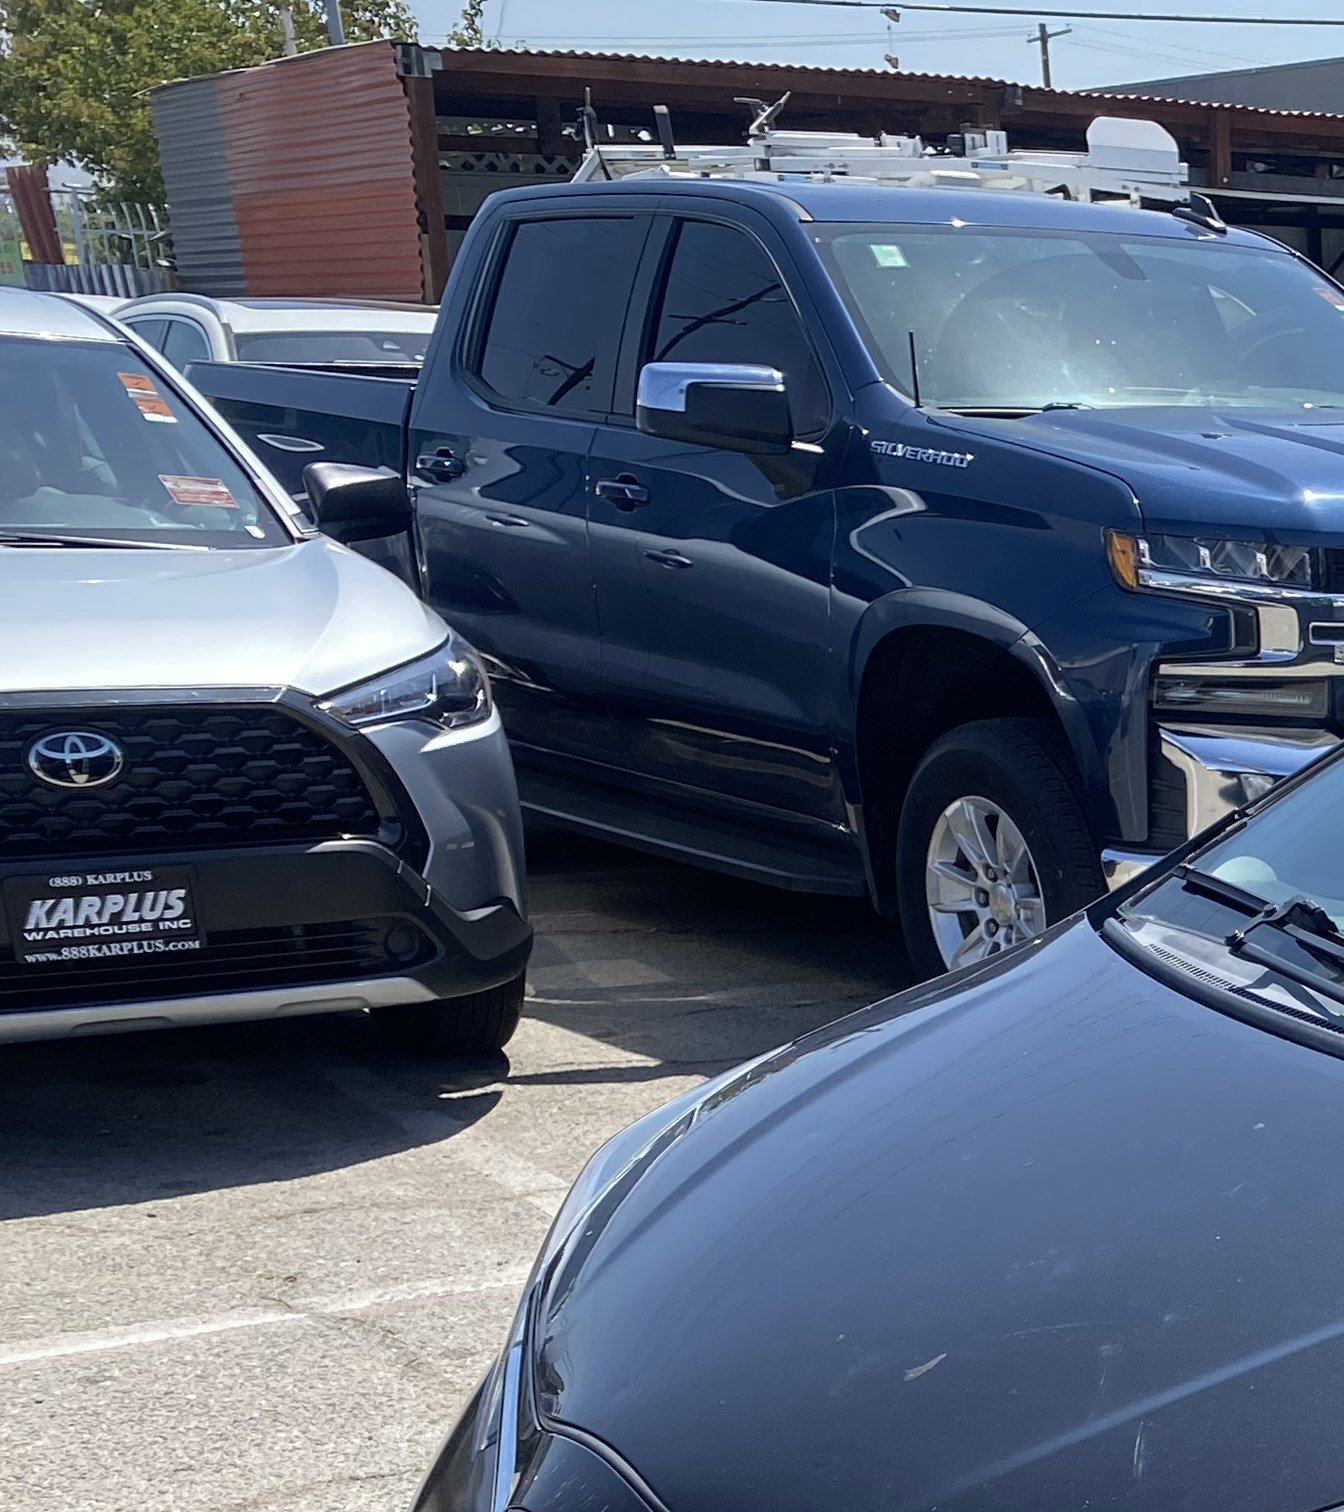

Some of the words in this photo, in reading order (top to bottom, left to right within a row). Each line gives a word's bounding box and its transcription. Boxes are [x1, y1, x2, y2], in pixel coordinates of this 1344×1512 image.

[870, 440, 974, 468] SILVERADO
[49, 873, 82, 888] (888)
[86, 870, 153, 886] KARPLUS
[23, 888, 187, 930] KARPLUS
[22, 922, 154, 941] WAREHOUSE
[158, 918, 193, 931] INC
